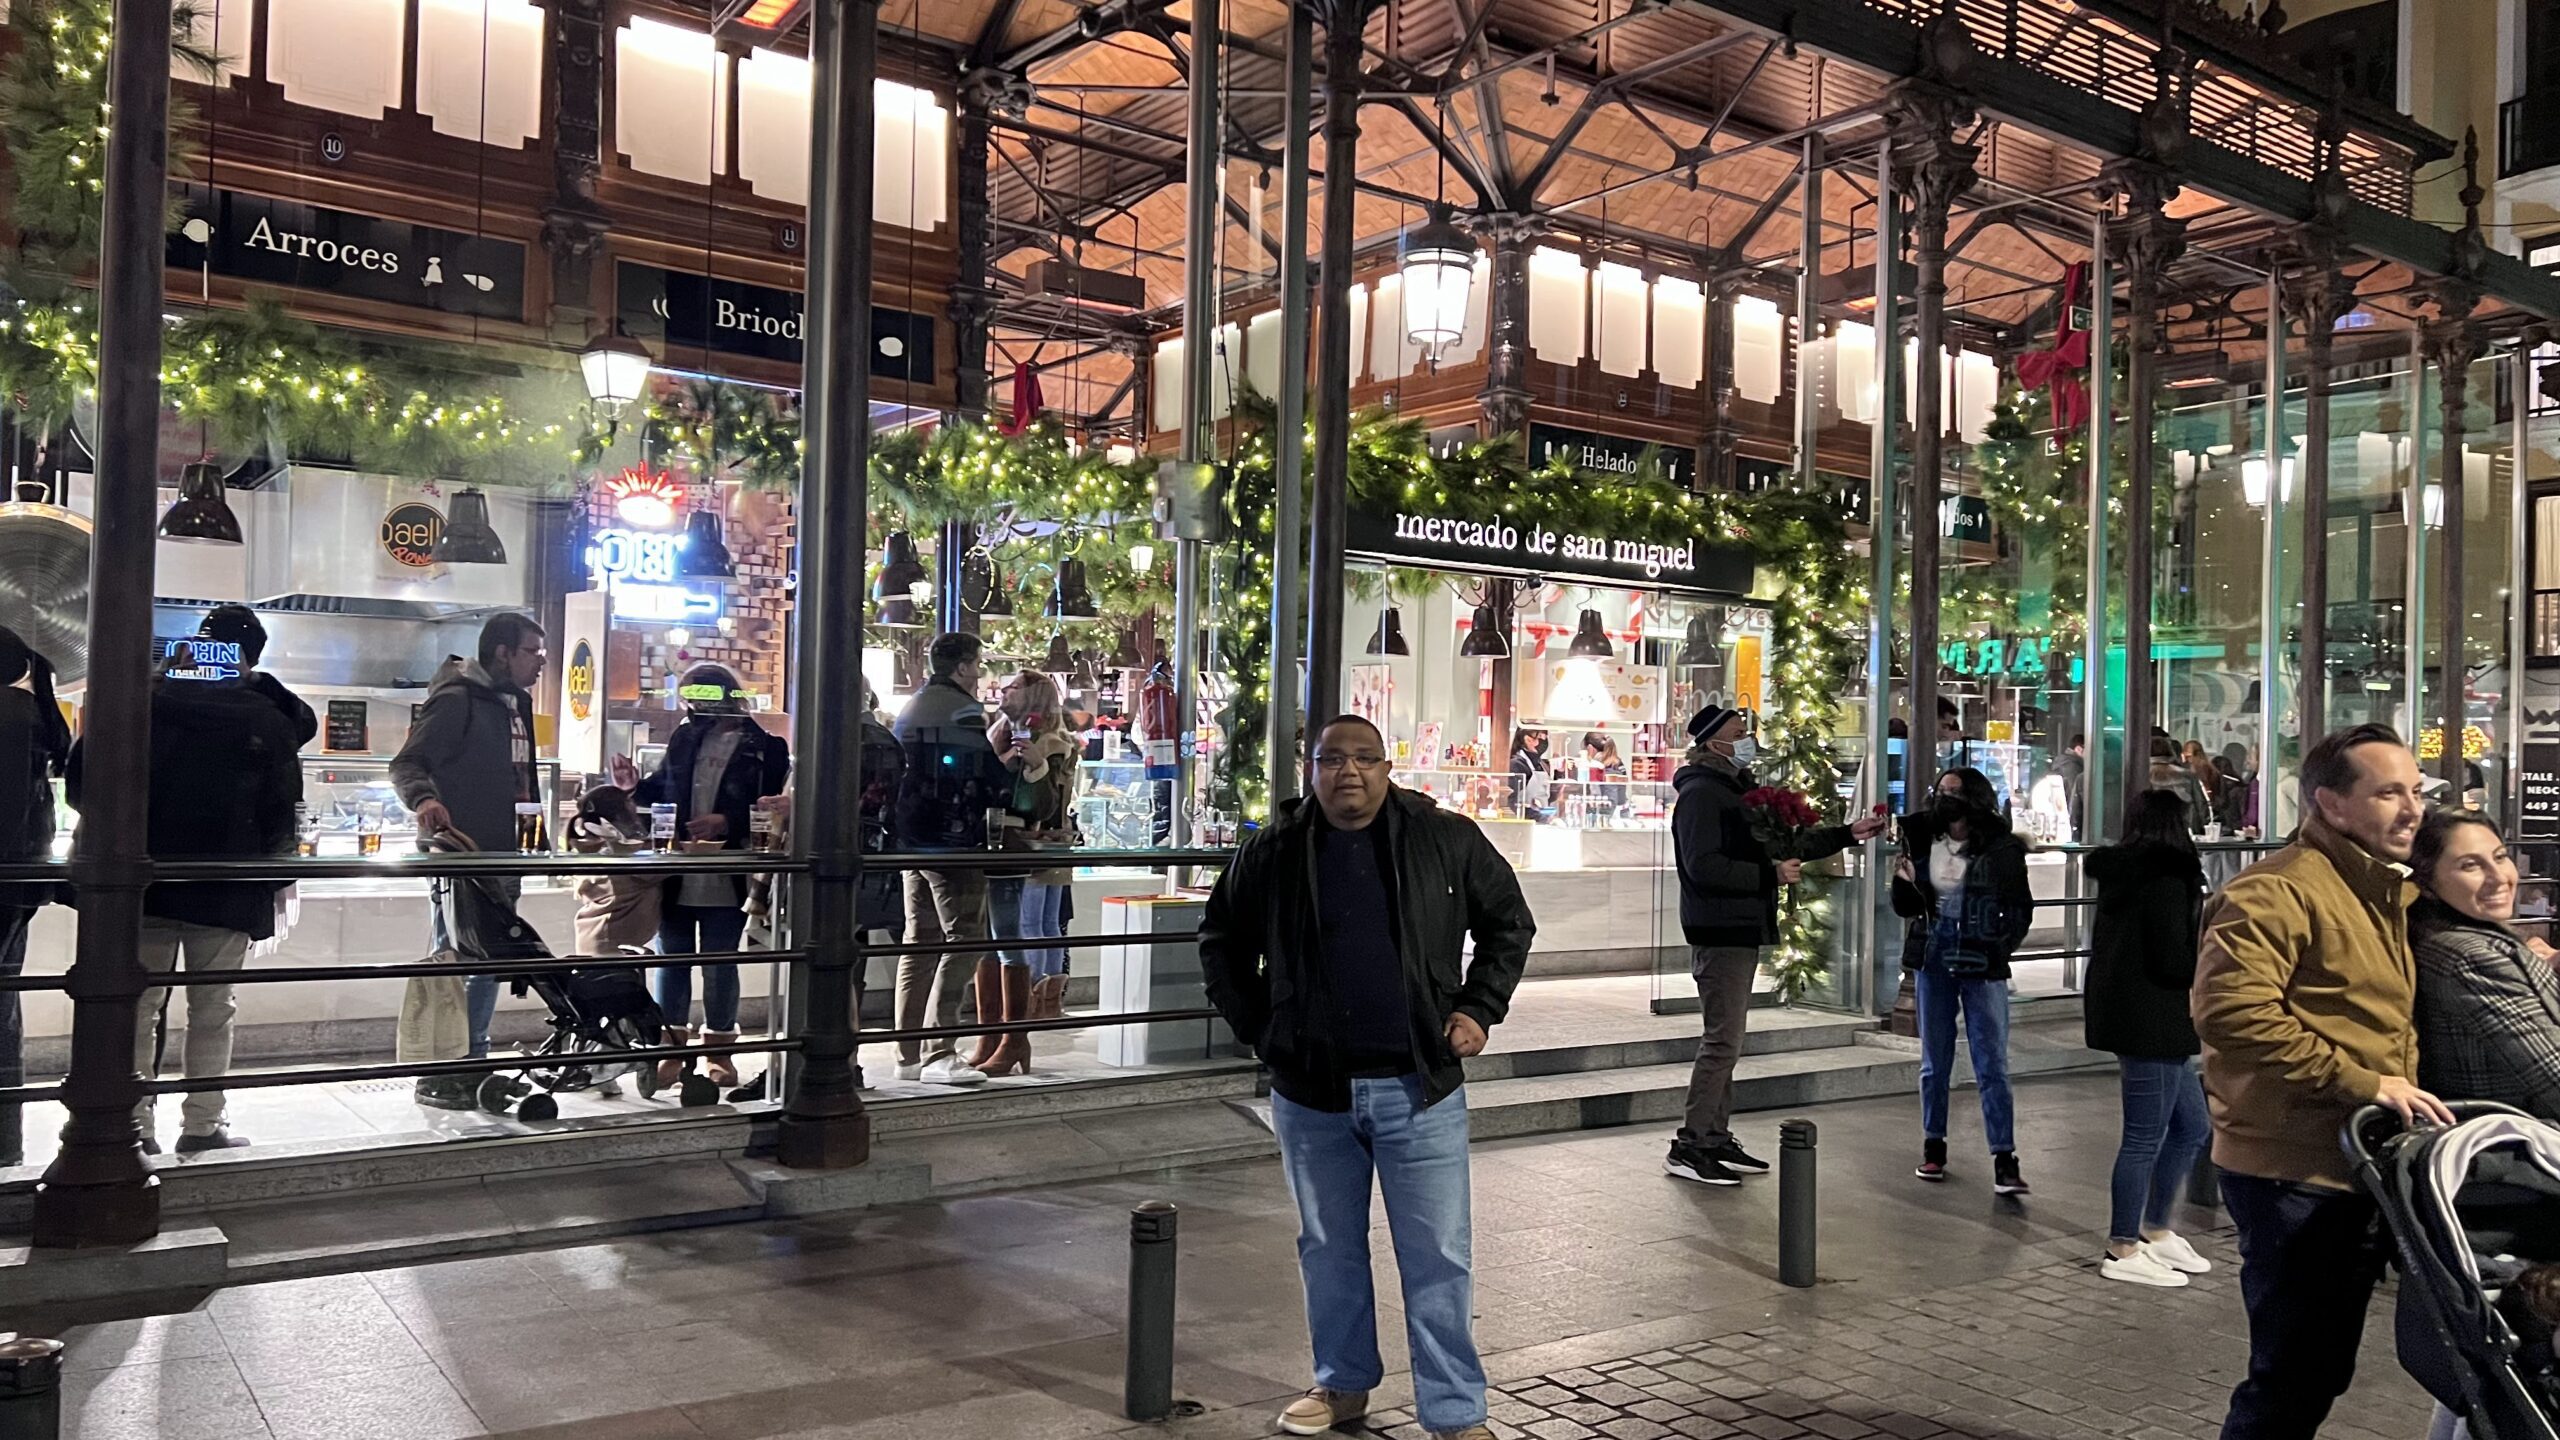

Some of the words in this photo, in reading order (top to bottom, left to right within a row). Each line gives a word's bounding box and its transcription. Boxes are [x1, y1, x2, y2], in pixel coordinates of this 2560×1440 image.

[326, 138, 342, 154] 10
[244, 216, 399, 274] Arroces
[1395, 512, 1519, 551] mercado
[1525, 521, 1557, 555] de
[1562, 533, 1608, 561] san
[1613, 535, 1696, 579] miguel
